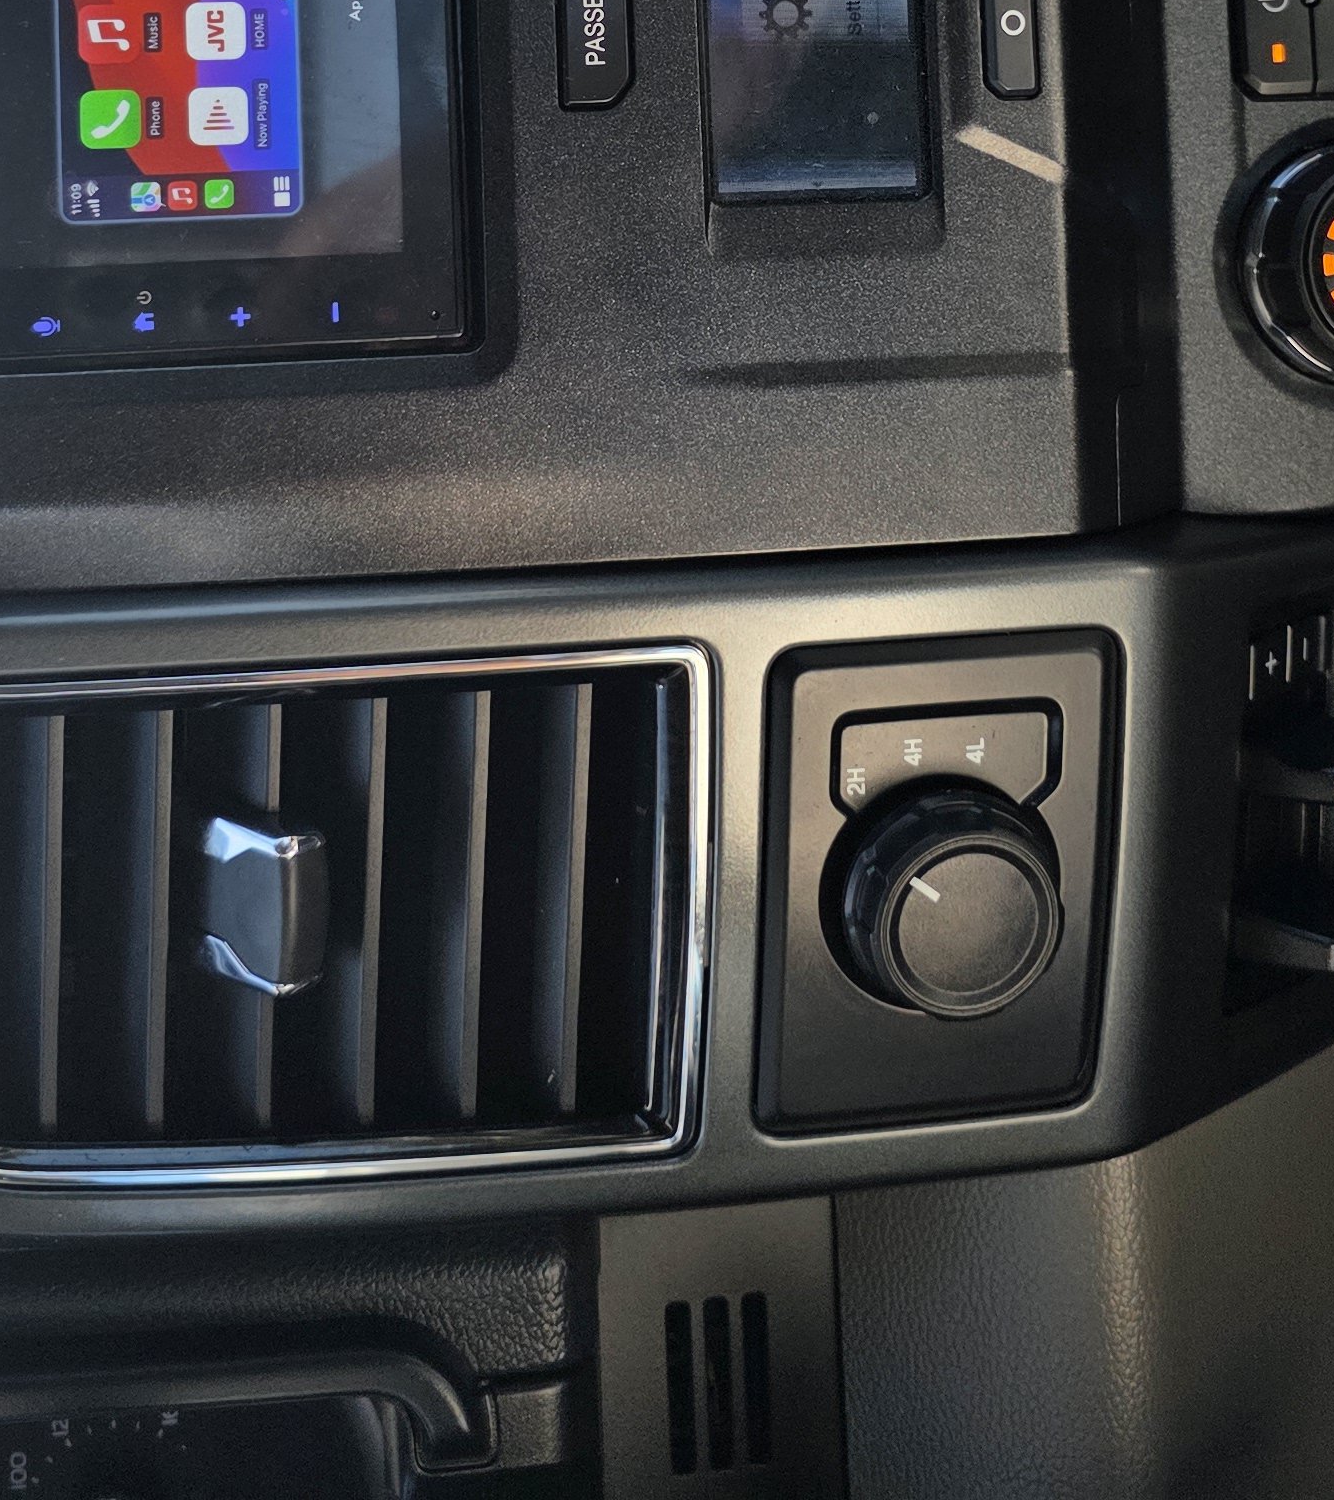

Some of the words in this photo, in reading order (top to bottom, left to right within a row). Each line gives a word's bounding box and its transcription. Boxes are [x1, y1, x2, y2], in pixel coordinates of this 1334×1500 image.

[146, 16, 159, 49] Music
[207, 10, 225, 52] JVC
[253, 13, 266, 48] HOME
[149, 100, 162, 136] Phone
[255, 82, 271, 122] Playing
[256, 124, 269, 148] Now
[70, 182, 83, 215] 11:09
[903, 738, 923, 766] 4H
[965, 736, 985, 765] 4L
[847, 766, 867, 795] 2H
[51, 1418, 69, 1436] 12
[10, 1451, 27, 1490] 100
